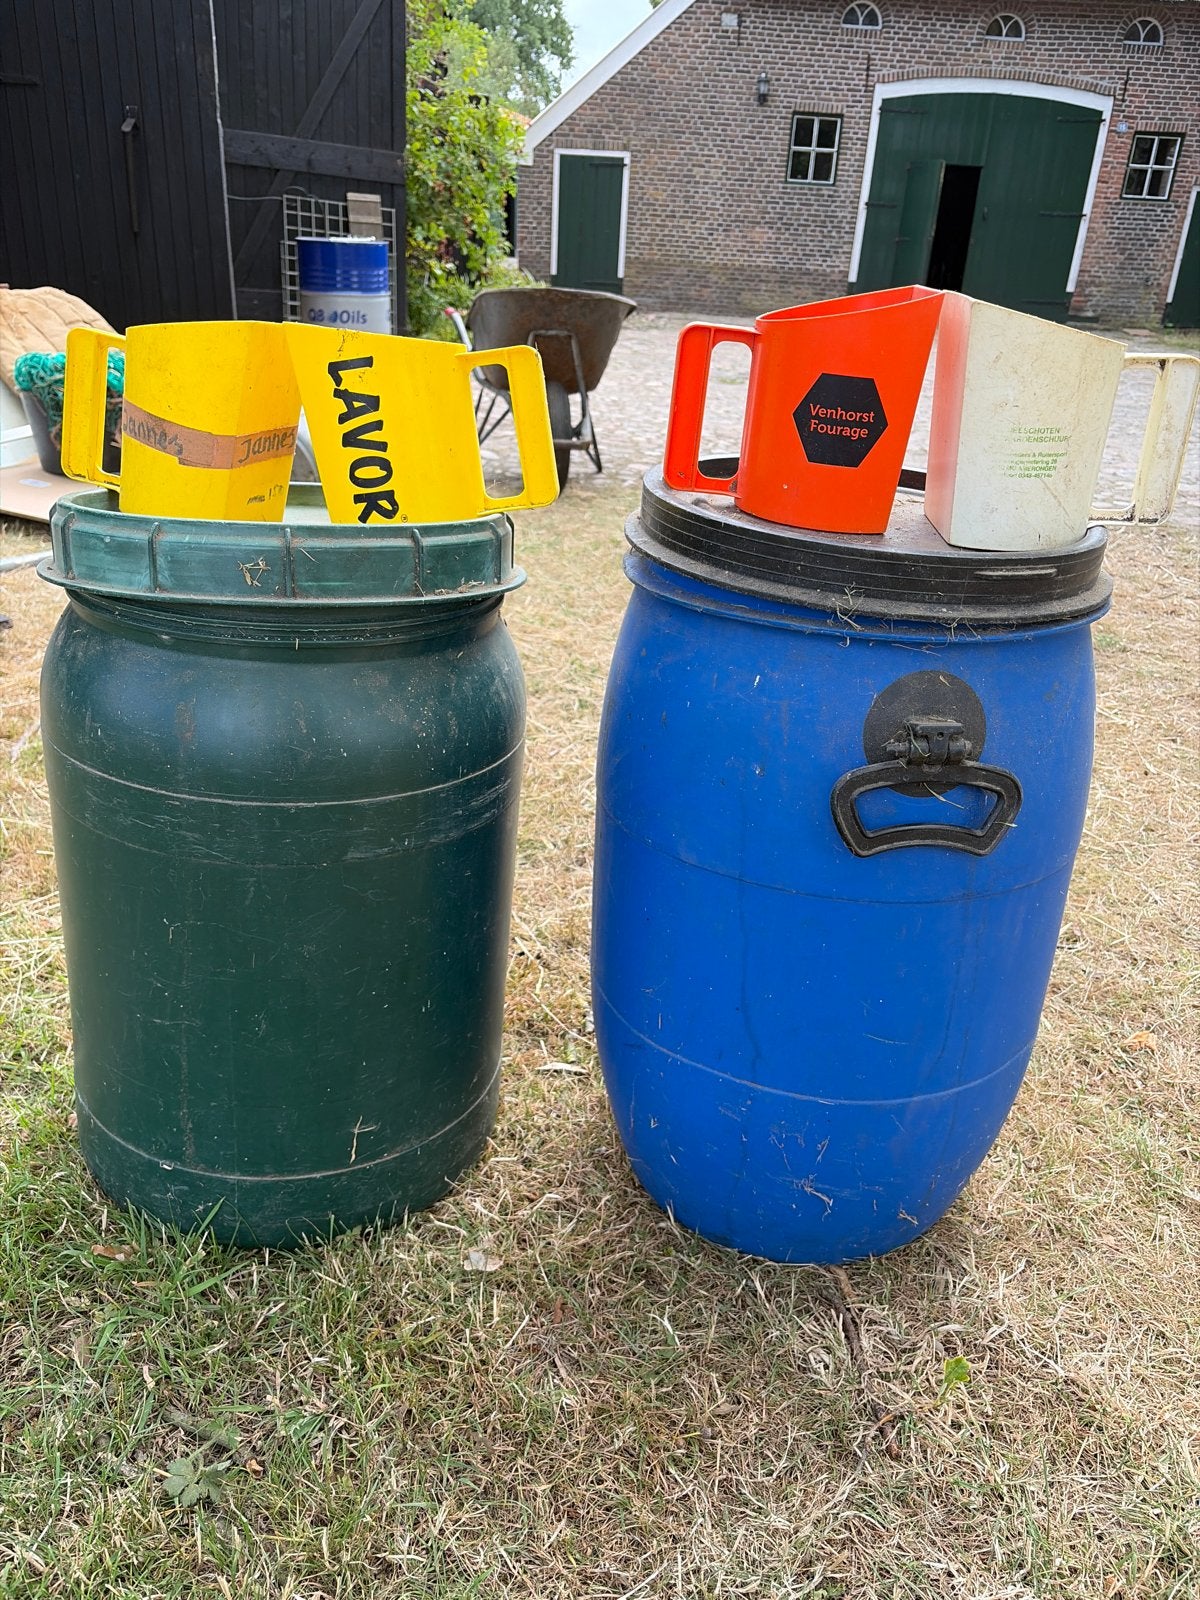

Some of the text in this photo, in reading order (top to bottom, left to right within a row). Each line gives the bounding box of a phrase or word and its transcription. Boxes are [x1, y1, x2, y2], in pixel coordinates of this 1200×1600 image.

[340, 310, 368, 324] Oils
[810, 403, 875, 423] Venhorst
[328, 356, 400, 524] LAVOR
[810, 420, 869, 440] Fourage
[239, 429, 296, 464] Jannes
